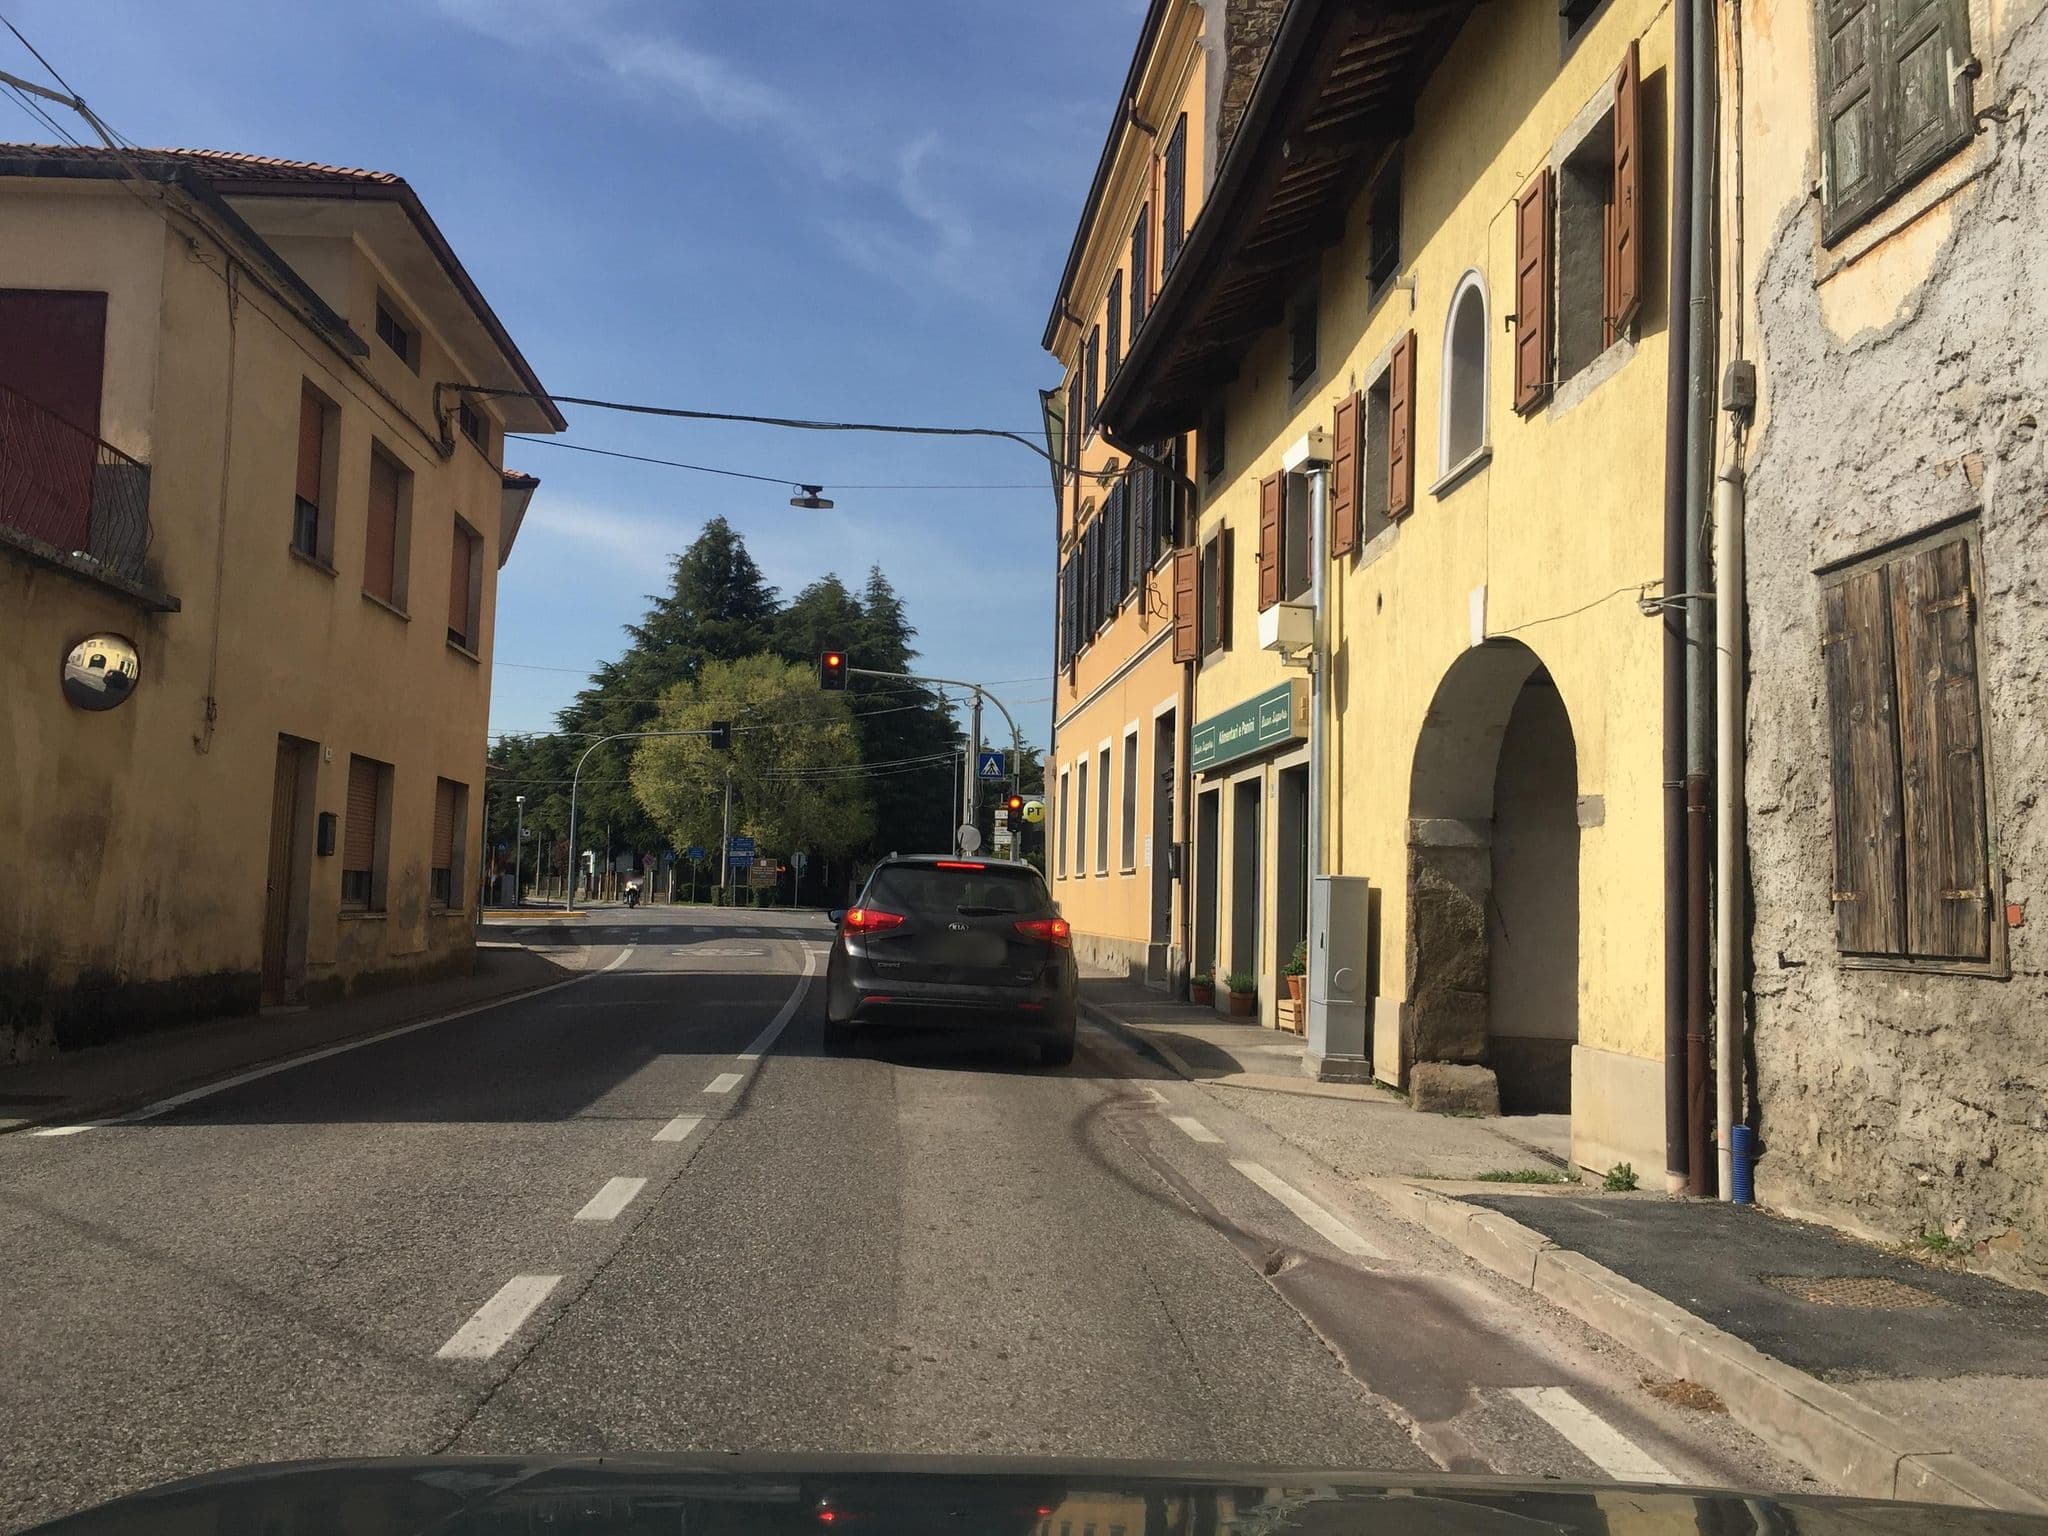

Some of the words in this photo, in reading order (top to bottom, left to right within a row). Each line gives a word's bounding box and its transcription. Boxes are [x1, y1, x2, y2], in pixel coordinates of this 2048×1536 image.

[1219, 723, 1238, 745] Alimentari
[1241, 716, 1254, 736] Panini
[1027, 806, 1043, 816] PT
